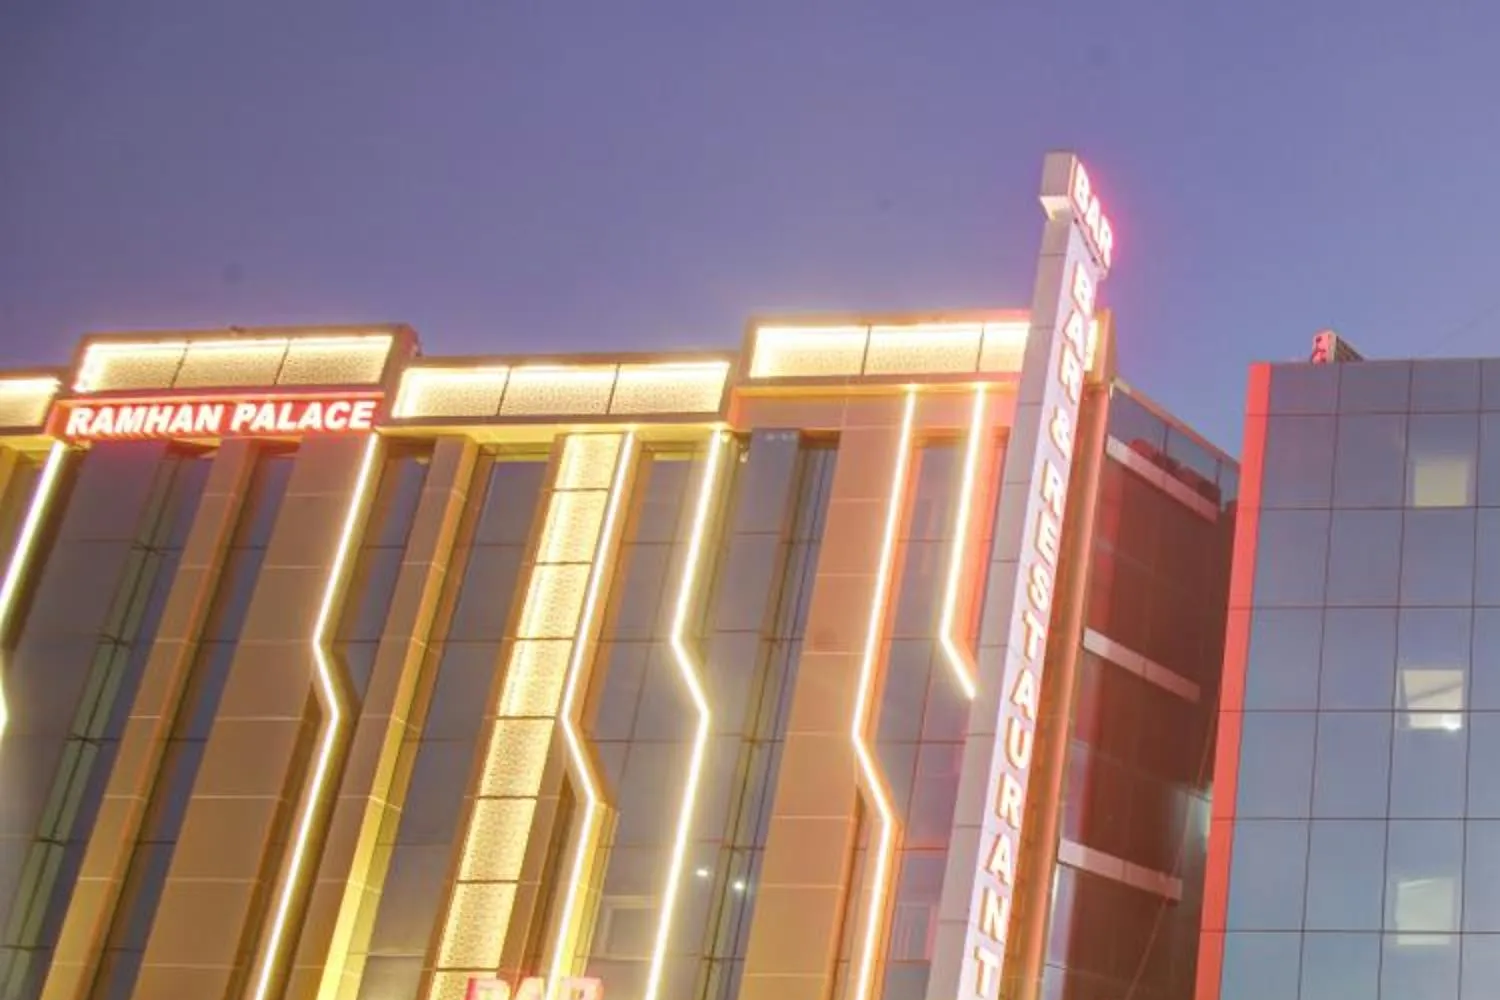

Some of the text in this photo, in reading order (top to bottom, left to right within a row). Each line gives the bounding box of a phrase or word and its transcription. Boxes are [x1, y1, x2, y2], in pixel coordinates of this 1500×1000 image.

[1072, 162, 1114, 268] BAR
[1061, 259, 1094, 404] BAR
[65, 399, 376, 437] RAMHAN PALACE
[973, 459, 1065, 999] RESTAURANT
